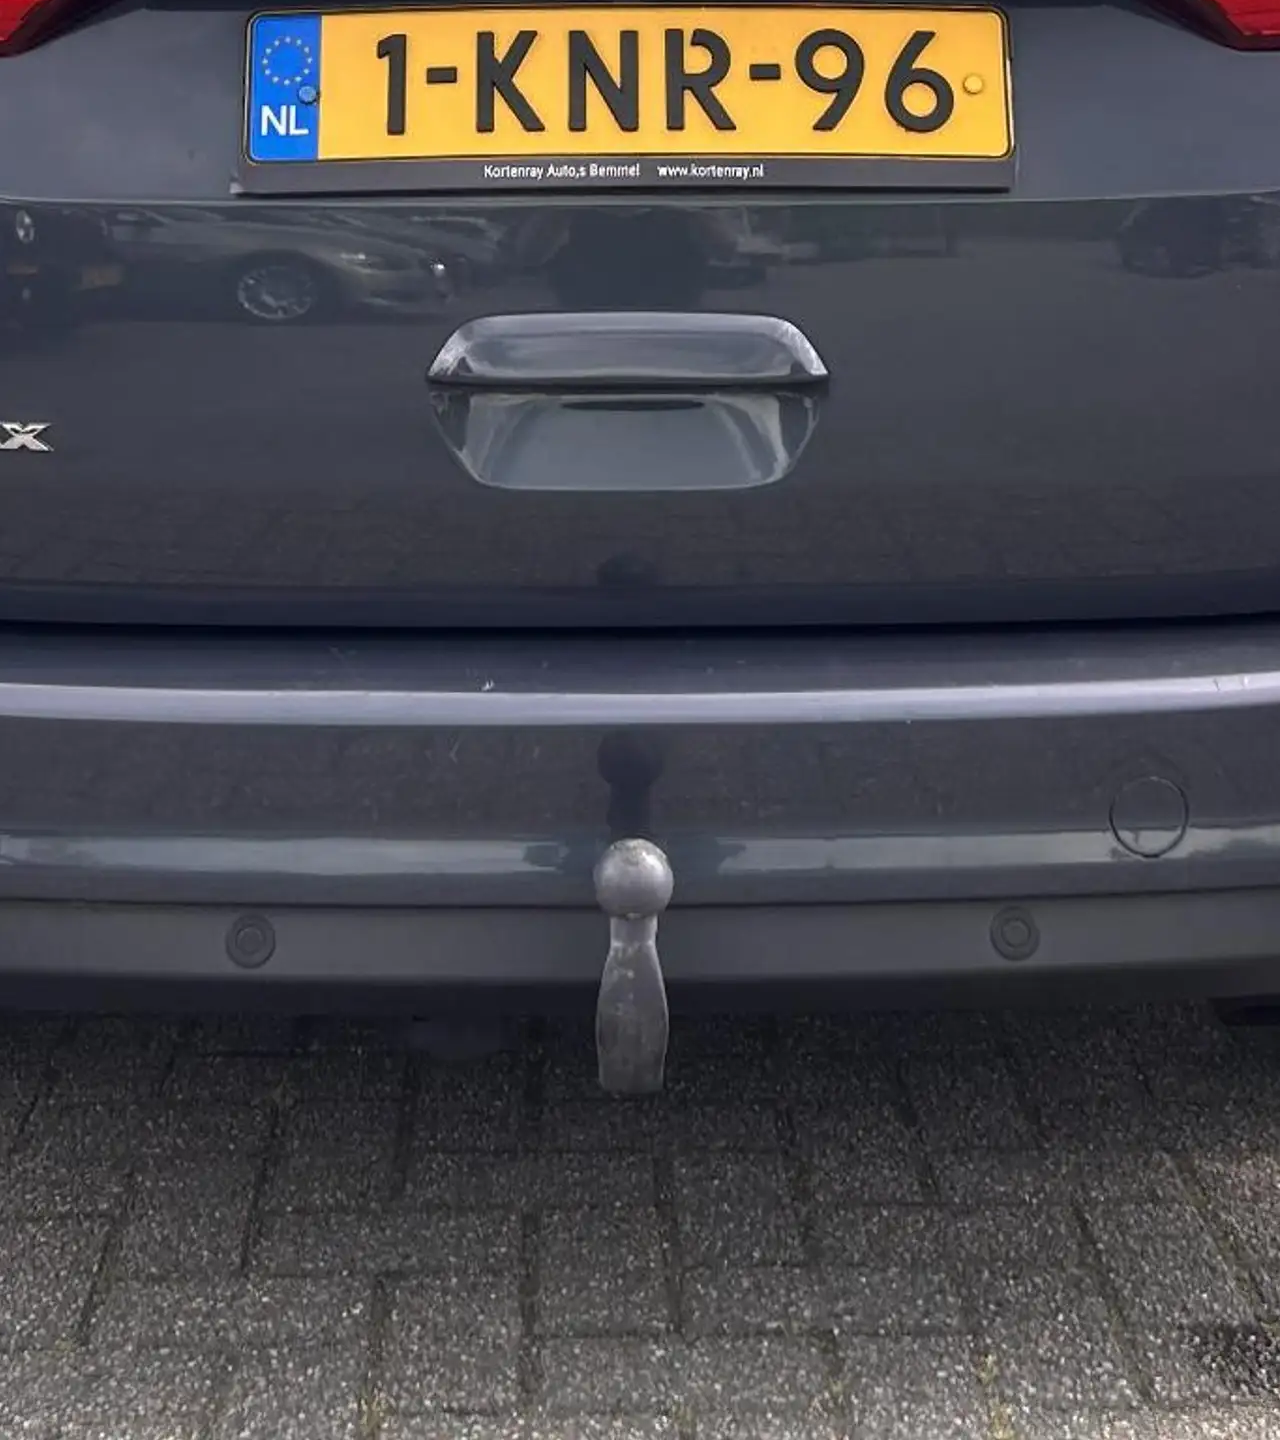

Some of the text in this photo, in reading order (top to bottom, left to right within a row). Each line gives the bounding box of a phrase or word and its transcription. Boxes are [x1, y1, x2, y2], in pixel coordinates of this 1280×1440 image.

[375, 27, 956, 135] 1-KNR-96
[261, 106, 308, 136] NL
[483, 163, 544, 180] Kortenray
[589, 162, 641, 177] Bemmel
[657, 162, 765, 180] www.kortenray.nl
